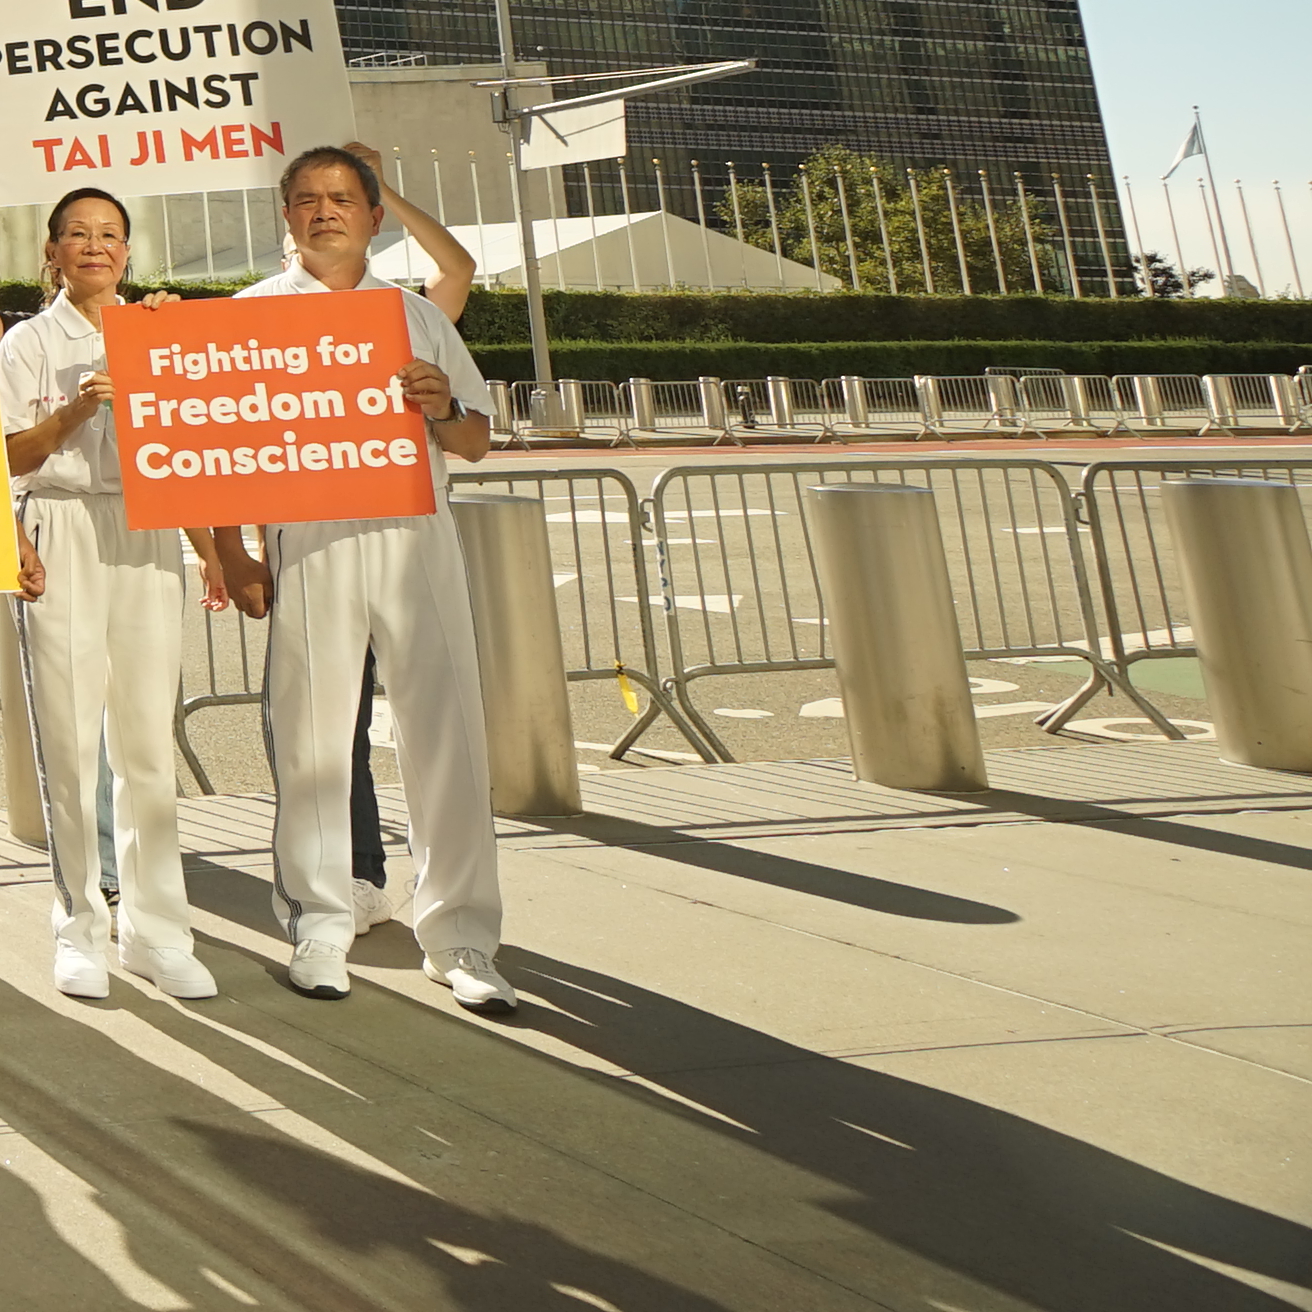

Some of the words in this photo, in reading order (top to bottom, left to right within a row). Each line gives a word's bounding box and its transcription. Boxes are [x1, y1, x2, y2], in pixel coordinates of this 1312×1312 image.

[45, 72, 259, 121] AGAINST
[32, 135, 111, 172] TAI
[130, 130, 166, 166] JI
[181, 121, 285, 161] MEN
[149, 339, 309, 380] Fighting
[315, 336, 374, 366] for
[129, 383, 345, 428] Freedom
[357, 375, 405, 415] of
[136, 431, 417, 479] Conscience
